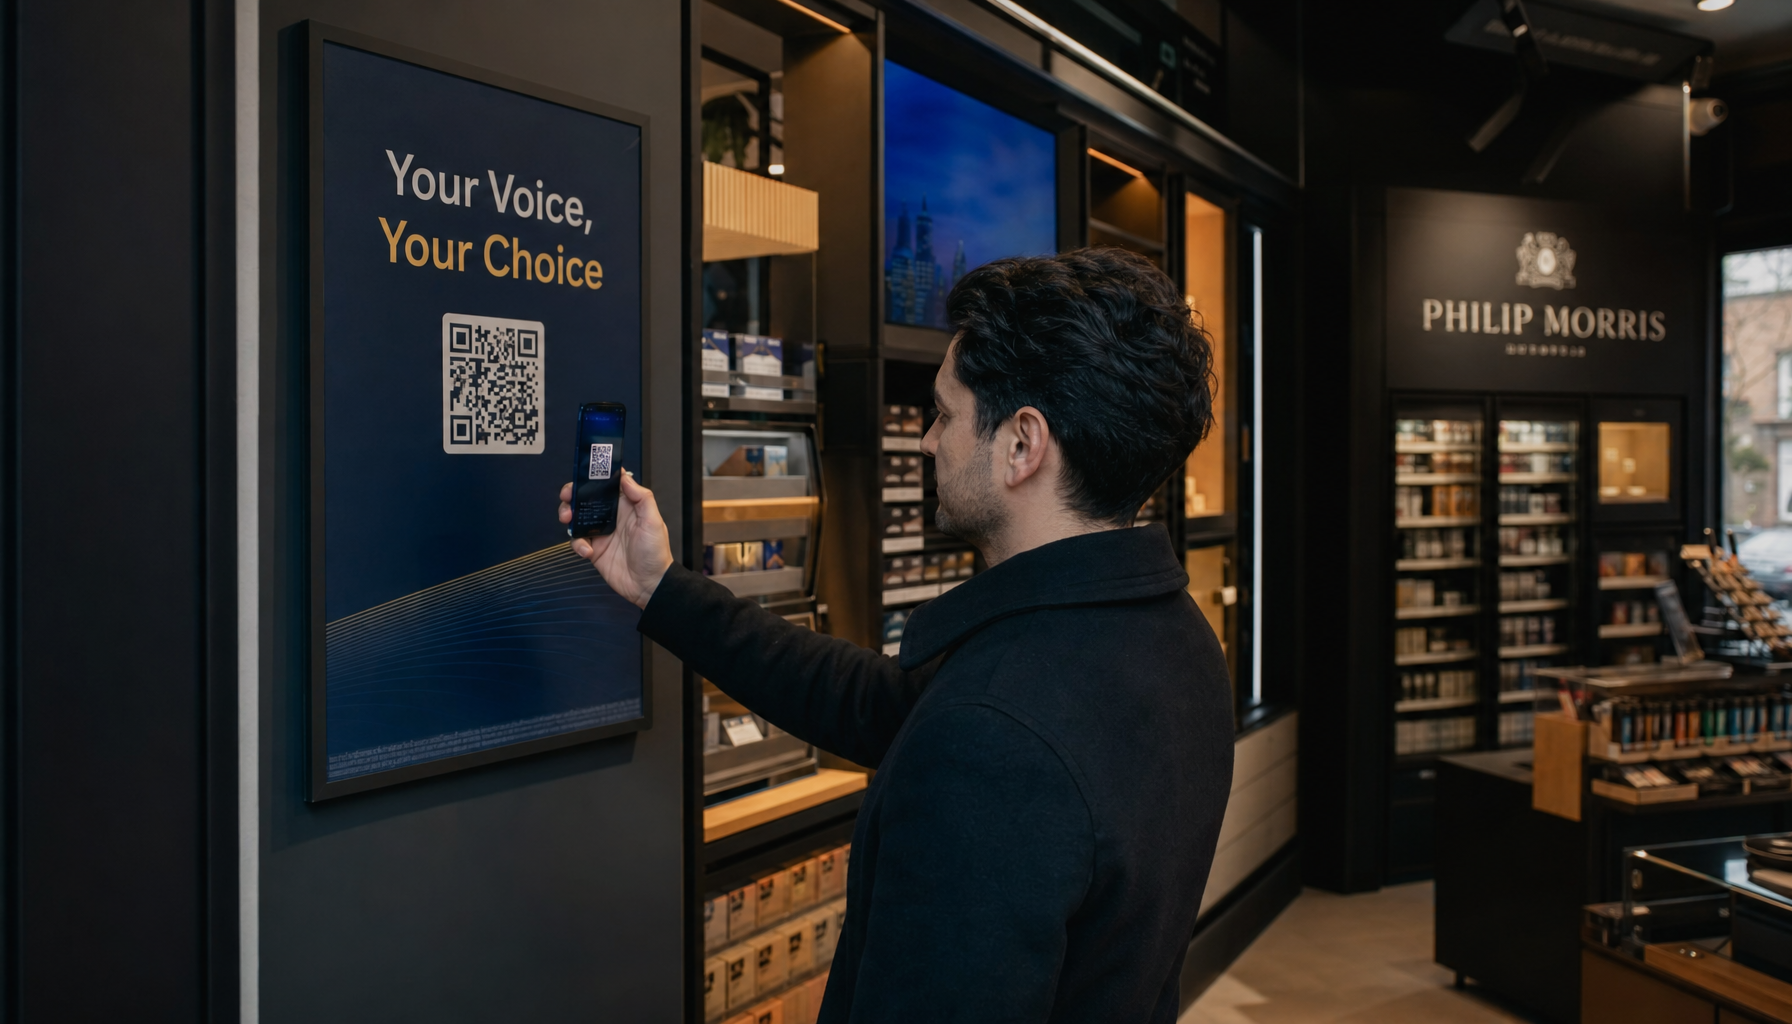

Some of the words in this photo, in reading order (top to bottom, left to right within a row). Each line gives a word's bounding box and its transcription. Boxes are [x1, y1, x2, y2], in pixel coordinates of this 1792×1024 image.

[385, 149, 479, 207] Your
[488, 170, 592, 234] Voice,
[379, 217, 473, 272] Your
[484, 234, 603, 290] Choice
[1423, 299, 1533, 335] PHILIP
[1544, 304, 1666, 341] MORRIS
